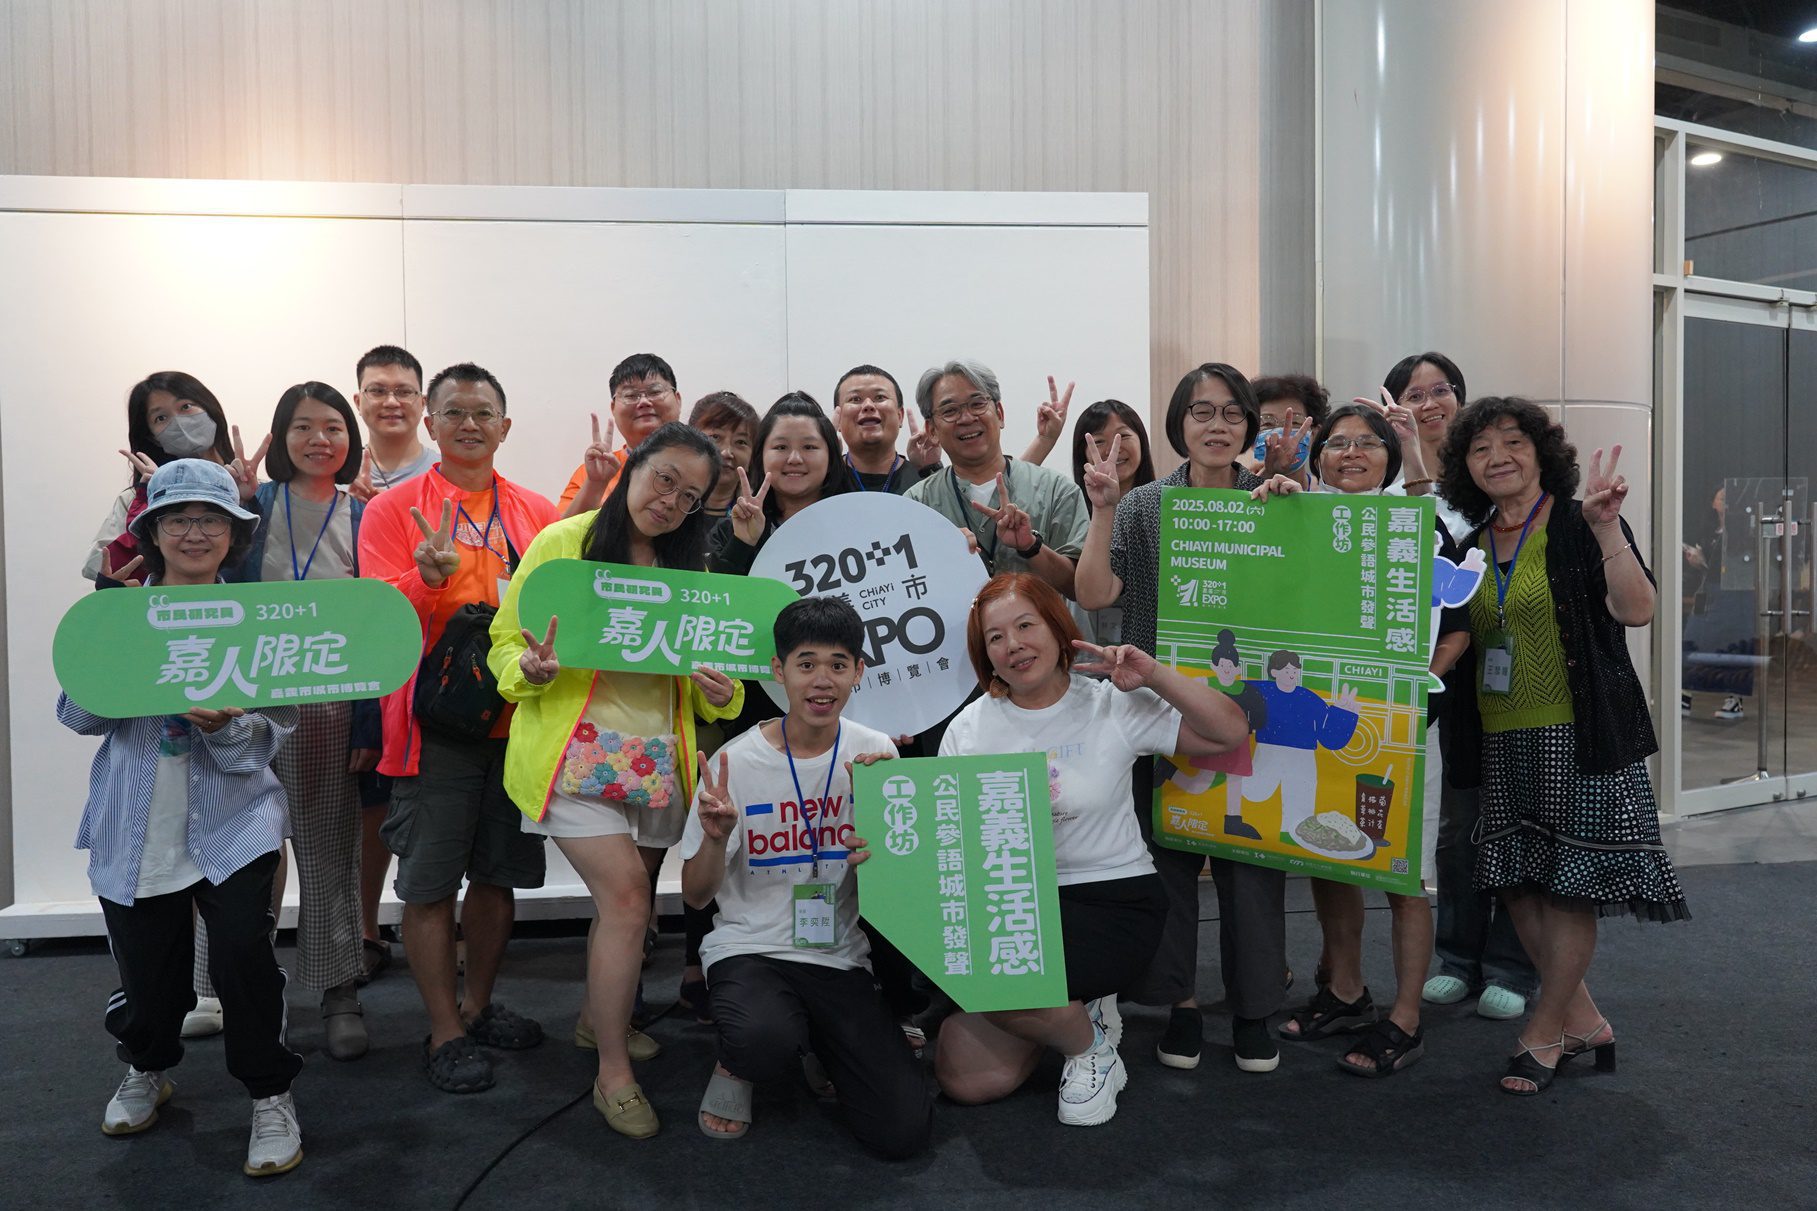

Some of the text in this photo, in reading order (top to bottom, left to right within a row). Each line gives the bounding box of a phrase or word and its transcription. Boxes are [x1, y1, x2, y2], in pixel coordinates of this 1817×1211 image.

[1171, 498, 1265, 516] 2025.08.02 (六)
[1333, 506, 1351, 553] 工作坊
[1170, 539, 1285, 558] CHIAYI MUNICIPAL
[1170, 556, 1227, 570] MUSEUM
[901, 573, 928, 600] 市
[1385, 507, 1419, 653] 嘉義生活感
[680, 588, 731, 606] 320+1
[1202, 594, 1228, 606] EXPO
[256, 602, 318, 621] 320+1
[598, 606, 756, 667] 嘉人限定
[155, 631, 350, 702] 嘉人限定
[1344, 665, 1382, 677] CHIAYI
[780, 795, 843, 823] new
[884, 777, 917, 853] 工作坊
[747, 823, 856, 855] balanc
[975, 770, 1040, 976] 嘉義生活感
